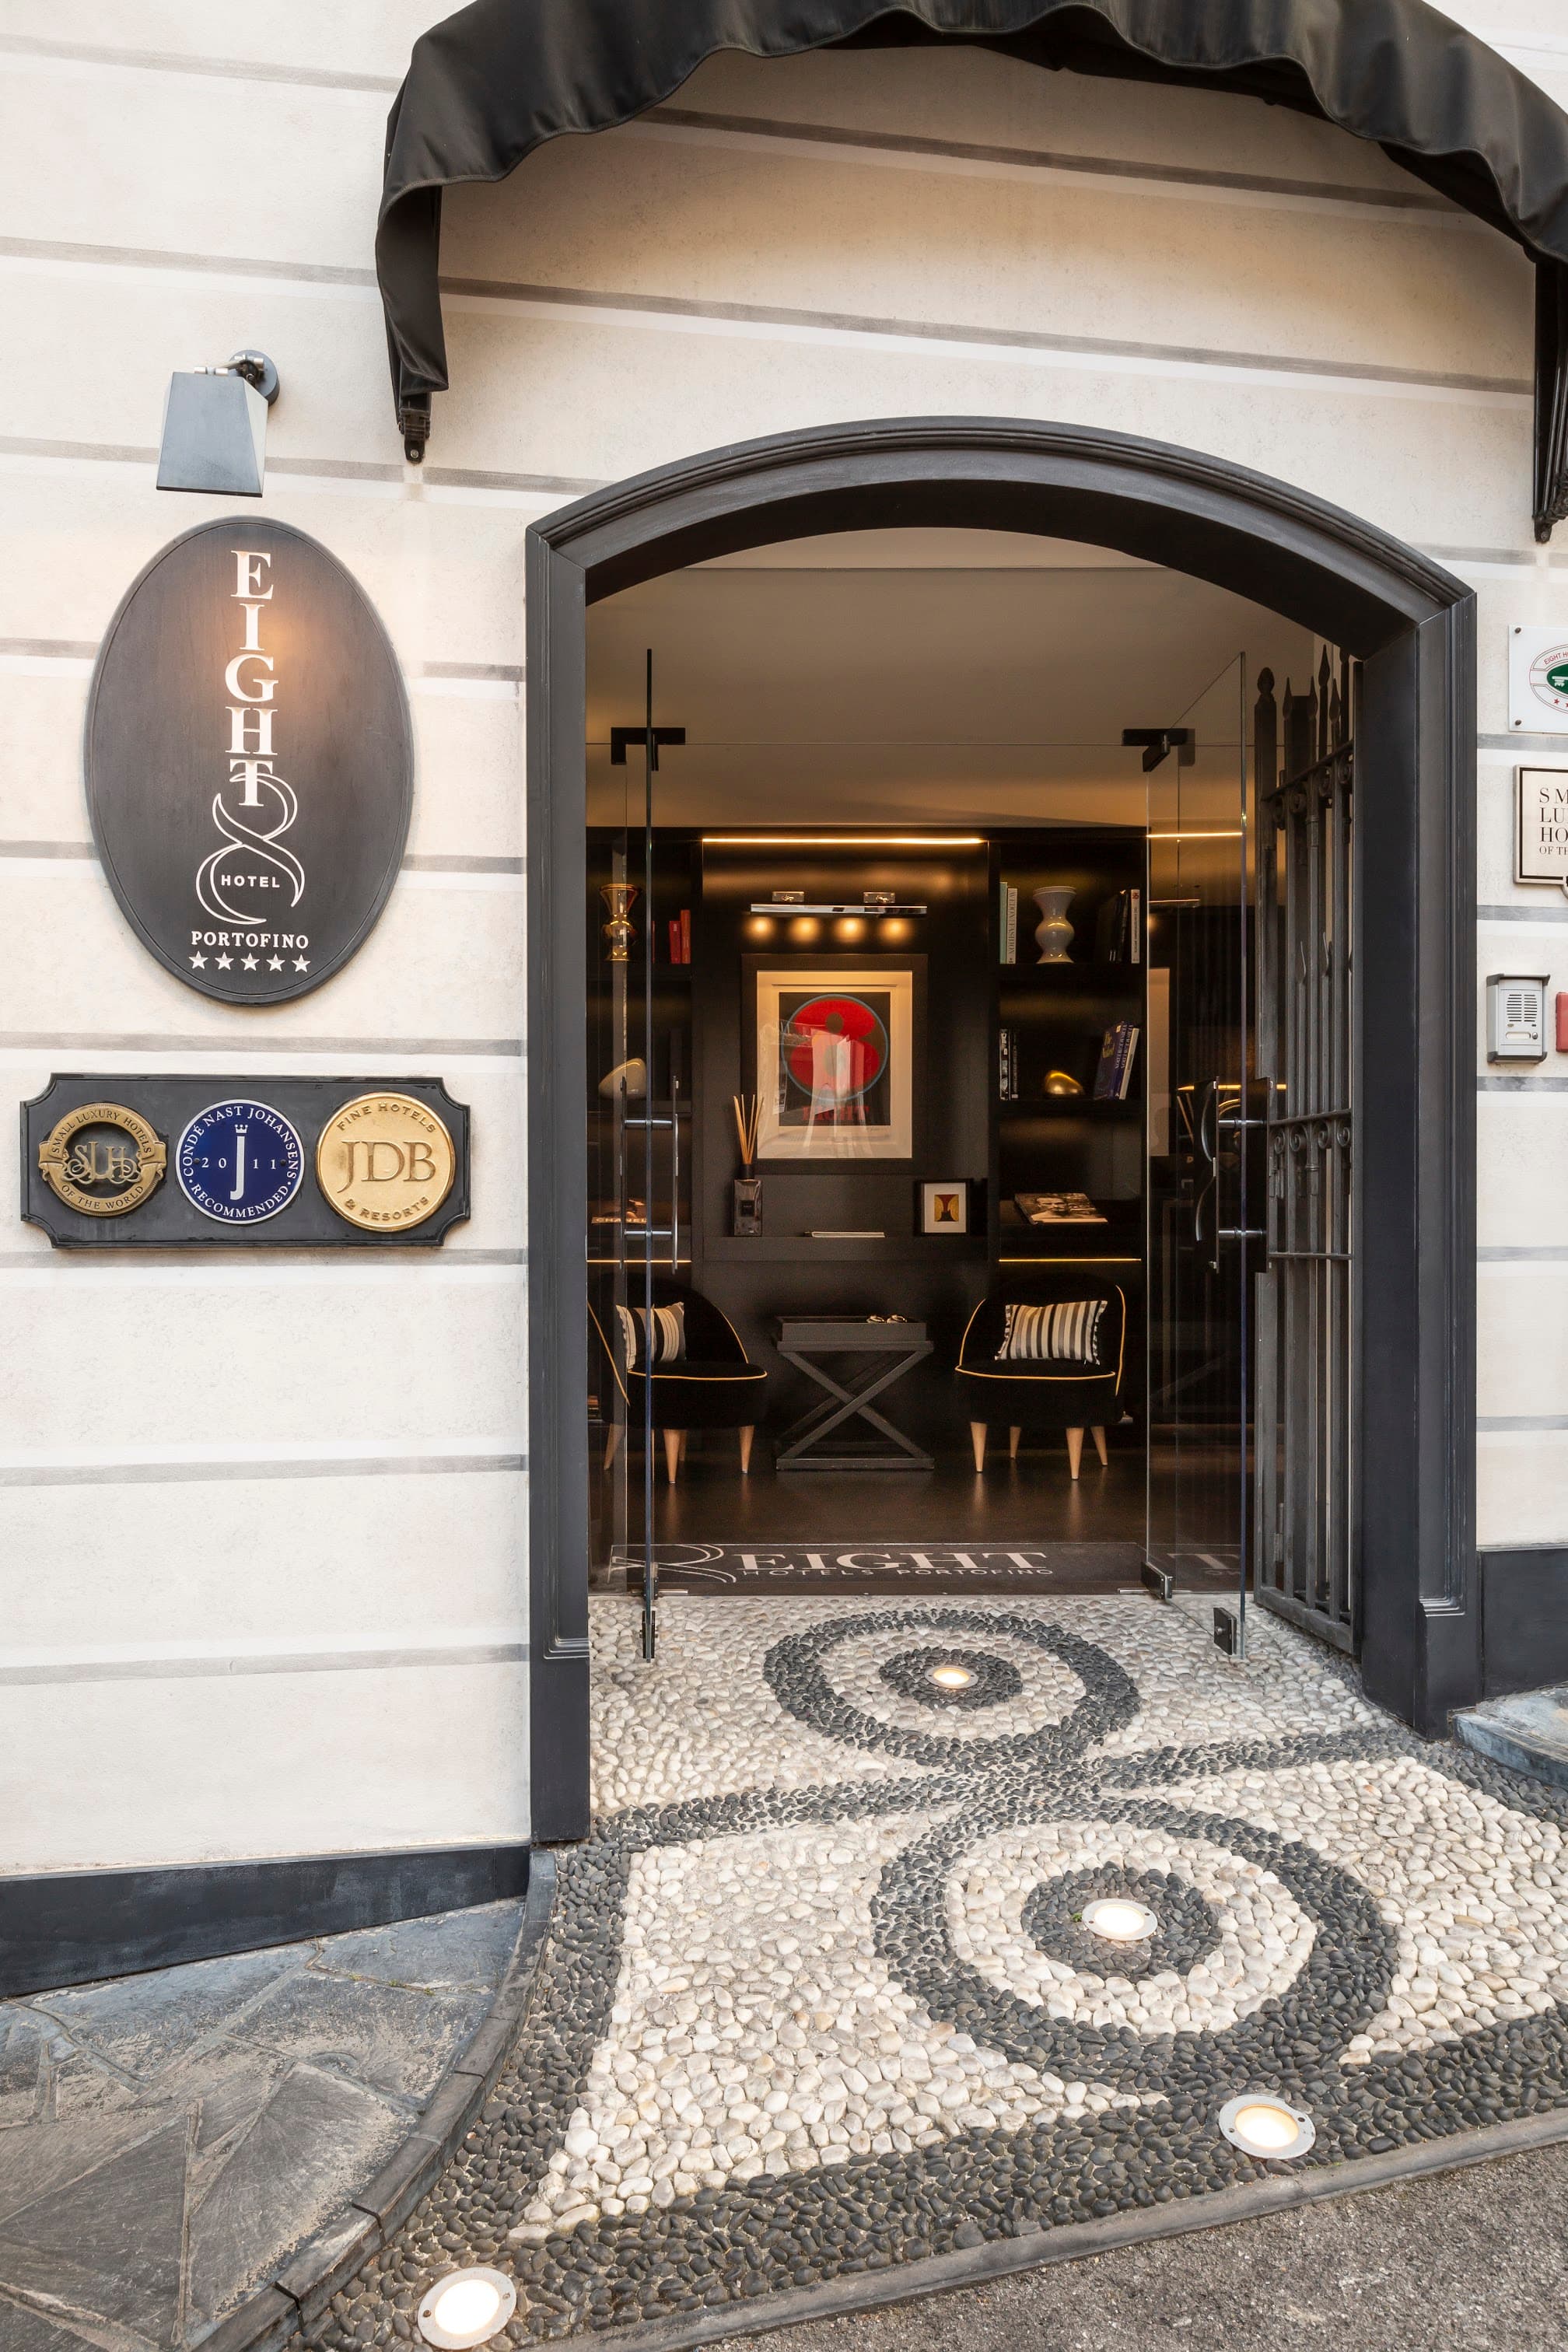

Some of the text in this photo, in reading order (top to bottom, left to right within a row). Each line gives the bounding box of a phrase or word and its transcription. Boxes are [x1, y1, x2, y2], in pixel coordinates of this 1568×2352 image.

[1544, 653, 1561, 665] EIGHT
[225, 550, 278, 807] EIGHT
[1538, 827, 1568, 843] HO
[1539, 845, 1554, 855] OF
[220, 874, 280, 888] HOTEL
[191, 930, 309, 950] PORTOFINO
[336, 1102, 436, 1133] FINE HOTELS
[52, 1109, 152, 1153] SMALL LUXURY HOTELS
[203, 1106, 243, 1127] NAST
[247, 1107, 299, 1179] JOHANSENS
[336, 1141, 436, 1194] JDB
[61, 1185, 144, 1209] OF THE WORLD
[191, 1183, 289, 1218] RECOMMENDED
[344, 1196, 429, 1221] & RESORTS
[733, 1552, 1048, 1570] EIGHT
